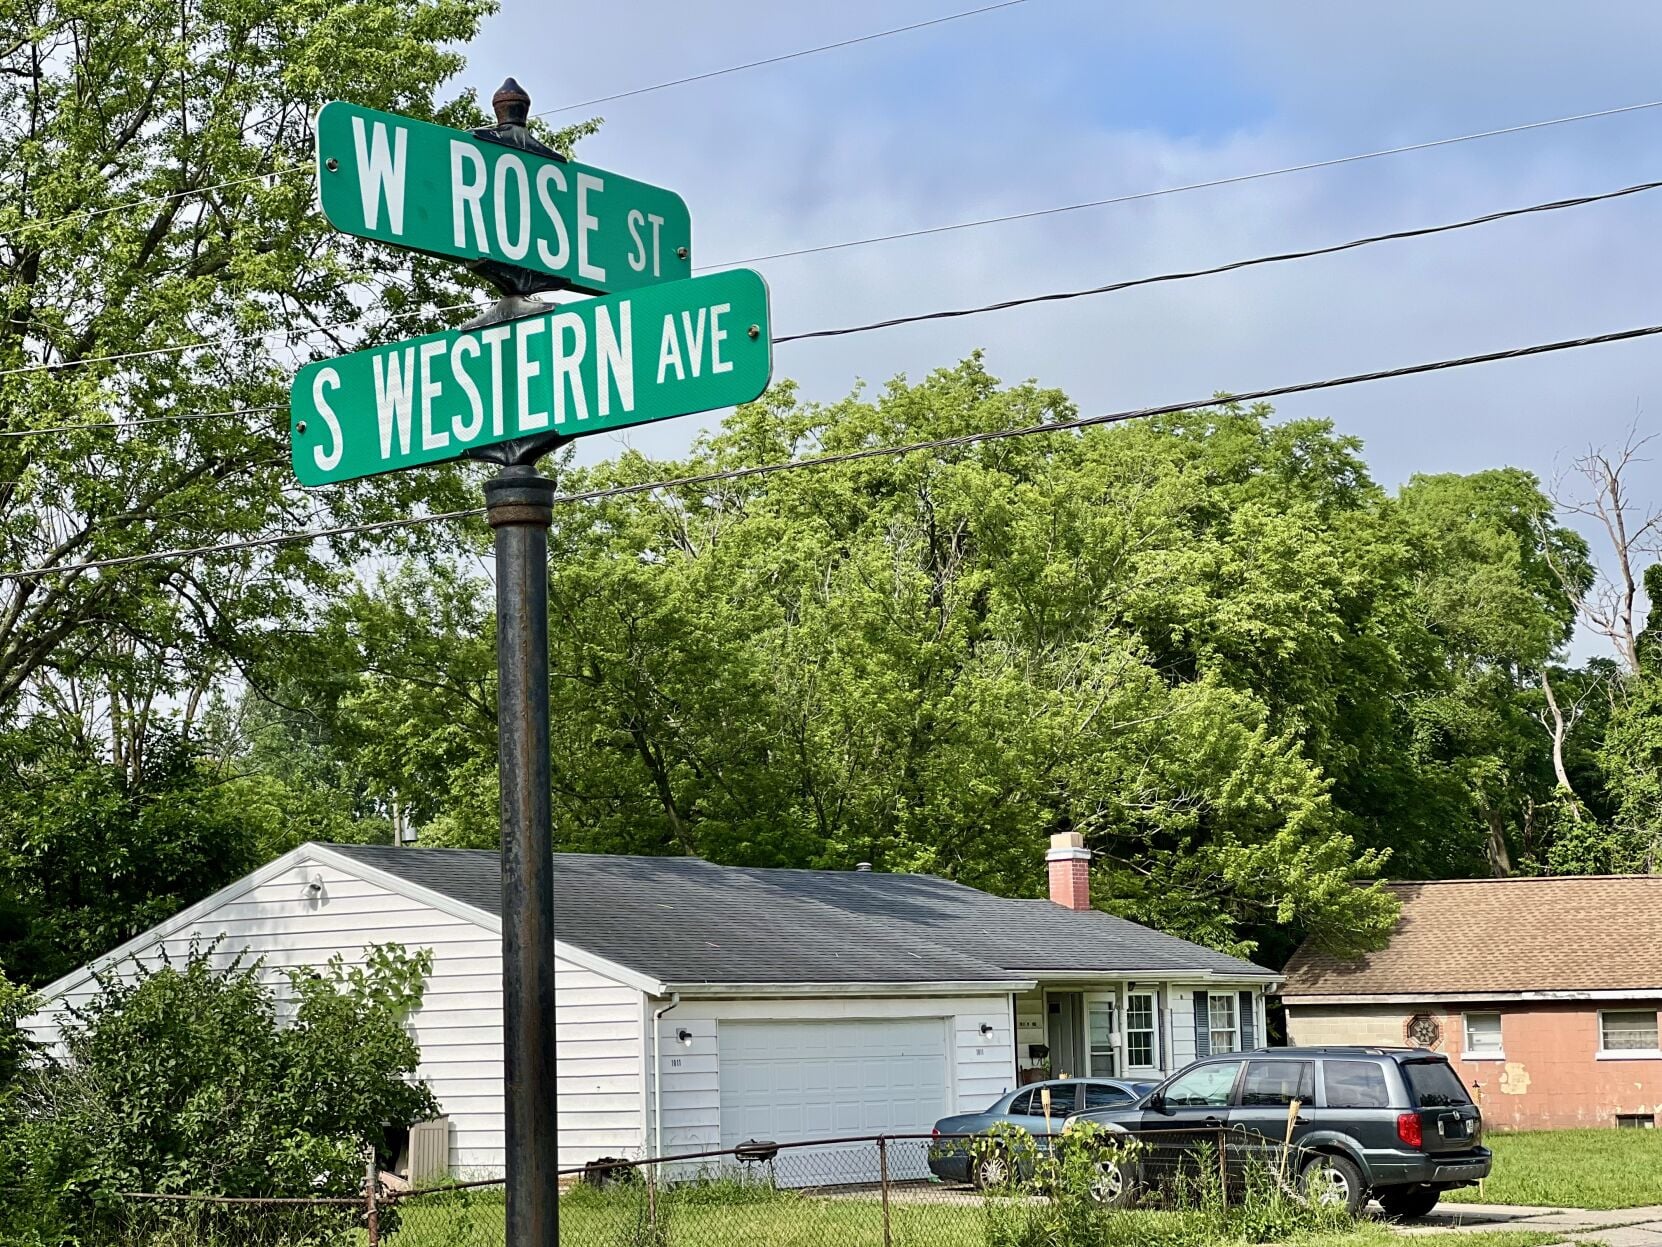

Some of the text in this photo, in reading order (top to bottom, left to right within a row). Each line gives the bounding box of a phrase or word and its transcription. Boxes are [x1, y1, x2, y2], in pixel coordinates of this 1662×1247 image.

[351, 116, 665, 283] W ROSE ST
[312, 300, 734, 471] S WESTERN AVE
